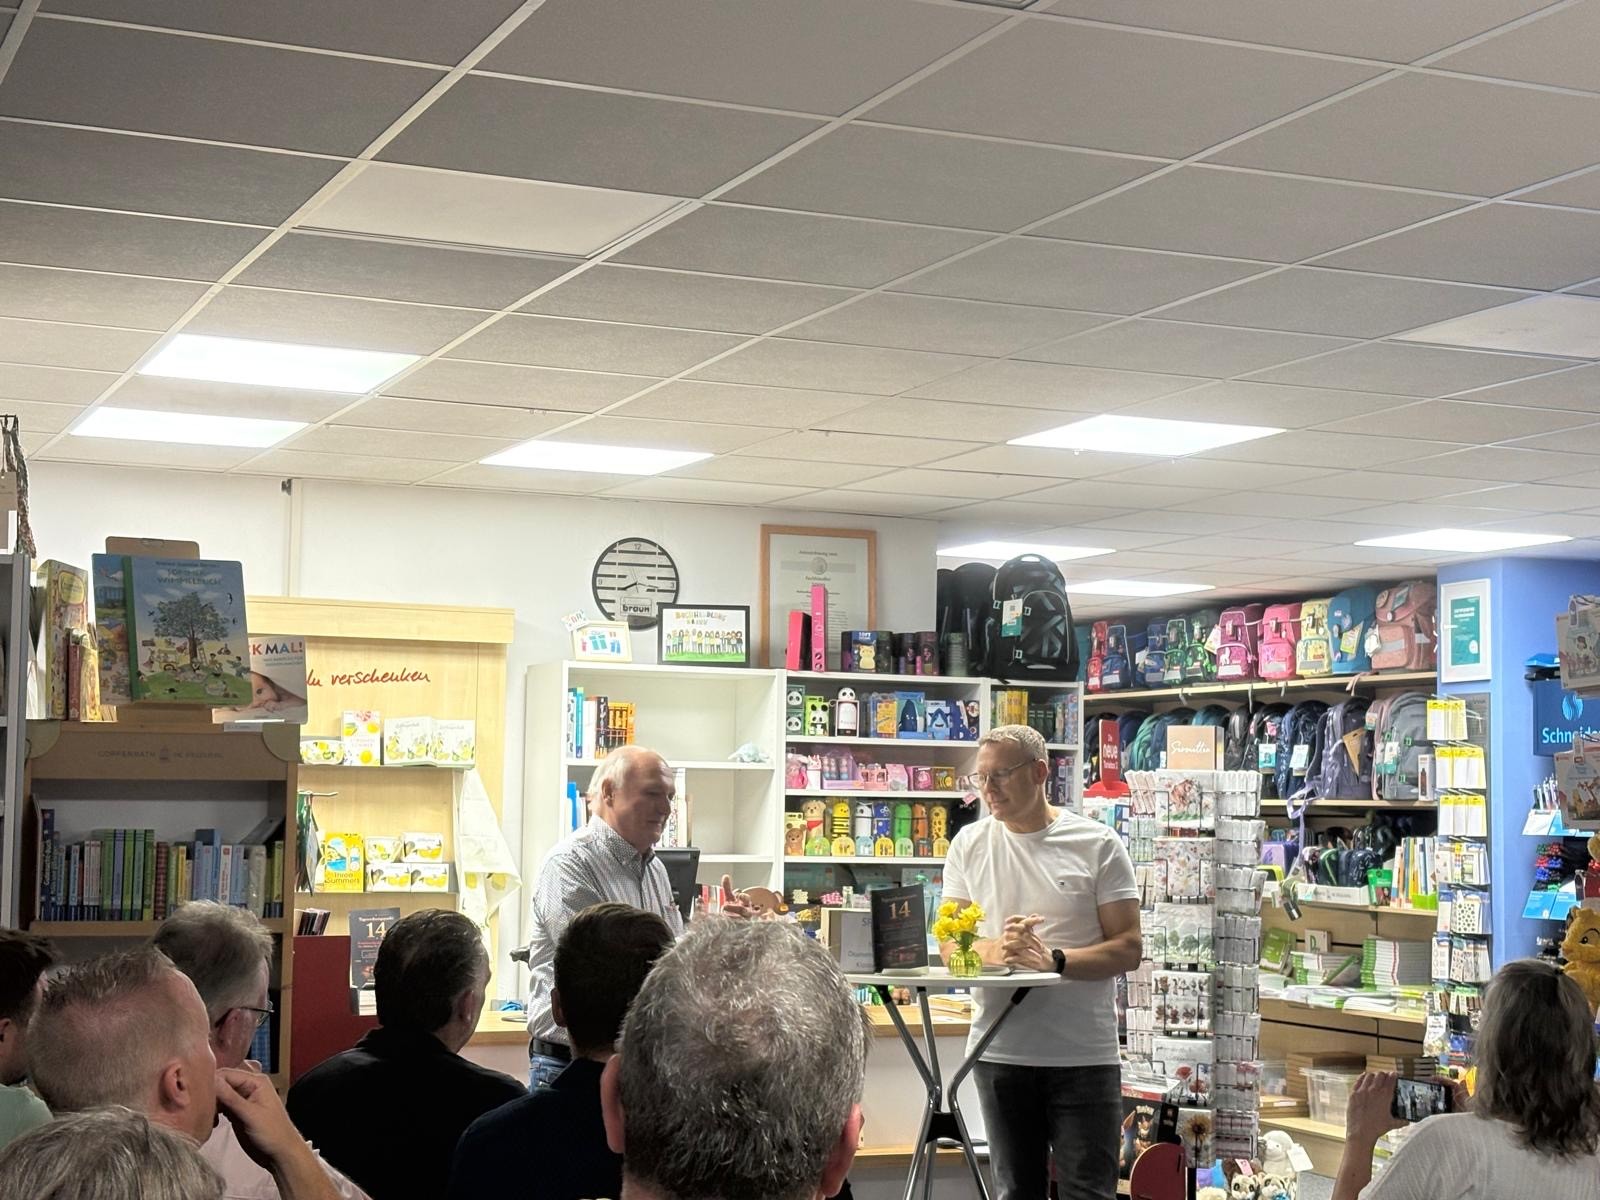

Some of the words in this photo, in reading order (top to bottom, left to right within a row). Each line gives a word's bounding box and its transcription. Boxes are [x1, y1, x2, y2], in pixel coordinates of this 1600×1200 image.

[622, 604, 650, 613] braun
[265, 642, 304, 655] MAL!
[331, 667, 431, 686] verschenken
[1102, 744, 1118, 759] neue
[889, 900, 911, 920] 14
[366, 921, 387, 938] 14
